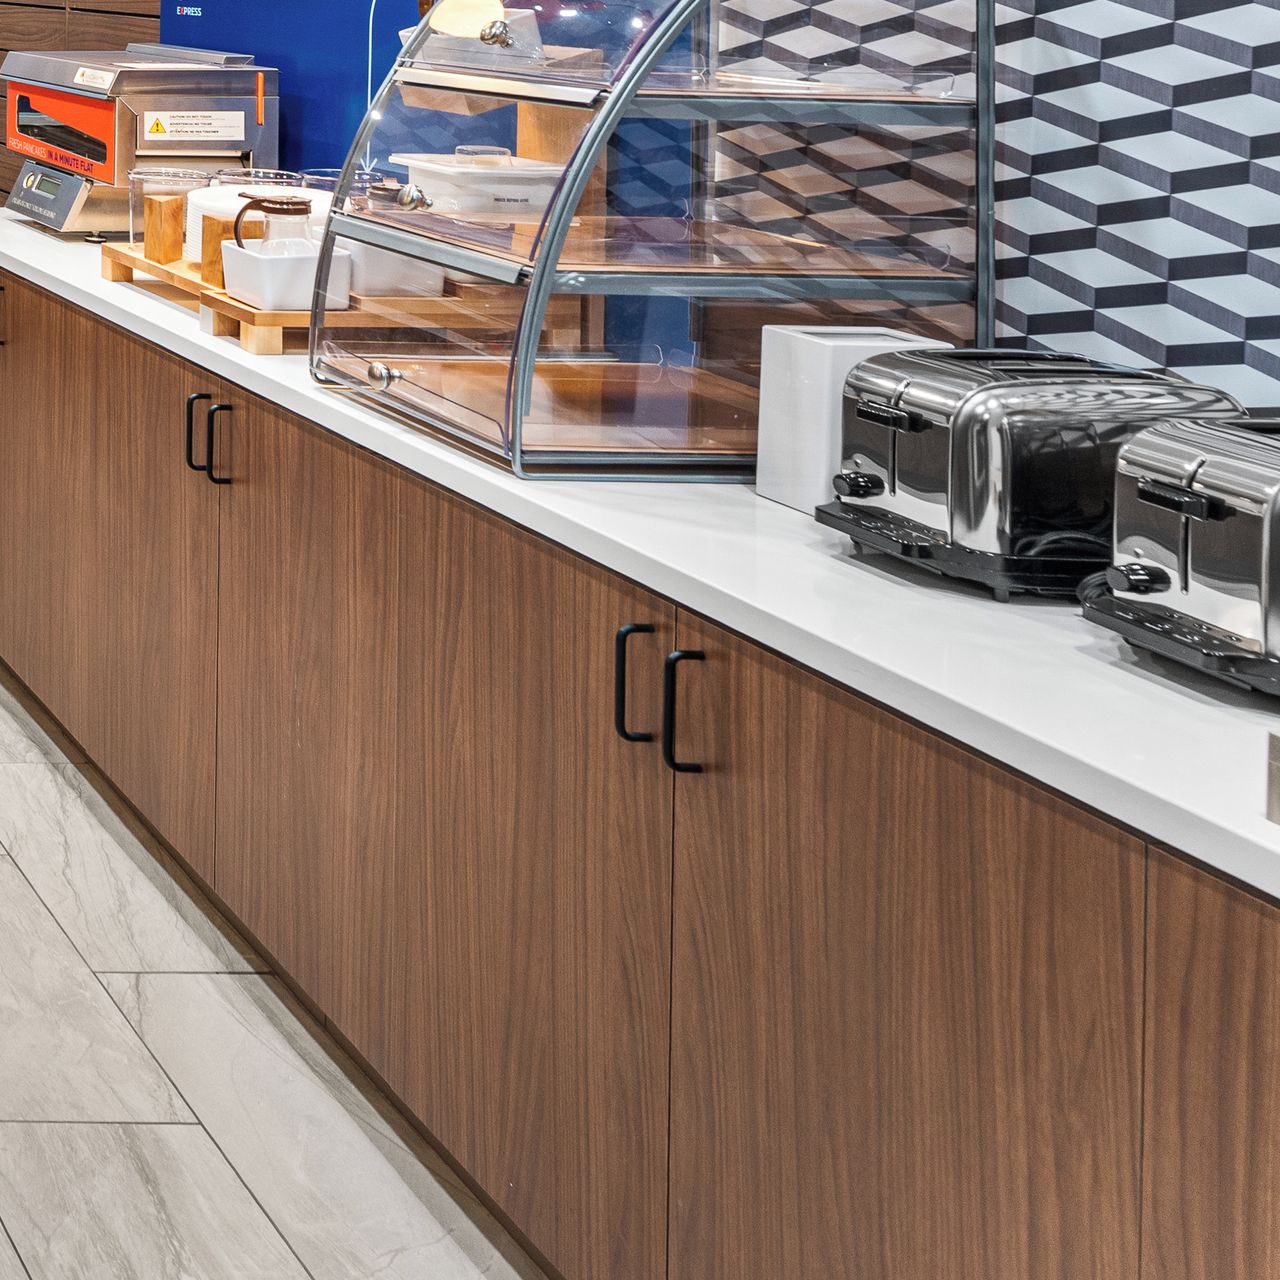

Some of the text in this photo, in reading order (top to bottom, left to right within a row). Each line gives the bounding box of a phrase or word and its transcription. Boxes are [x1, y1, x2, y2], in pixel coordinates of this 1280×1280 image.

[176, 6, 202, 16] EXPRESS
[60, 153, 79, 169] MINUTE
[81, 162, 94, 173] FLAT
